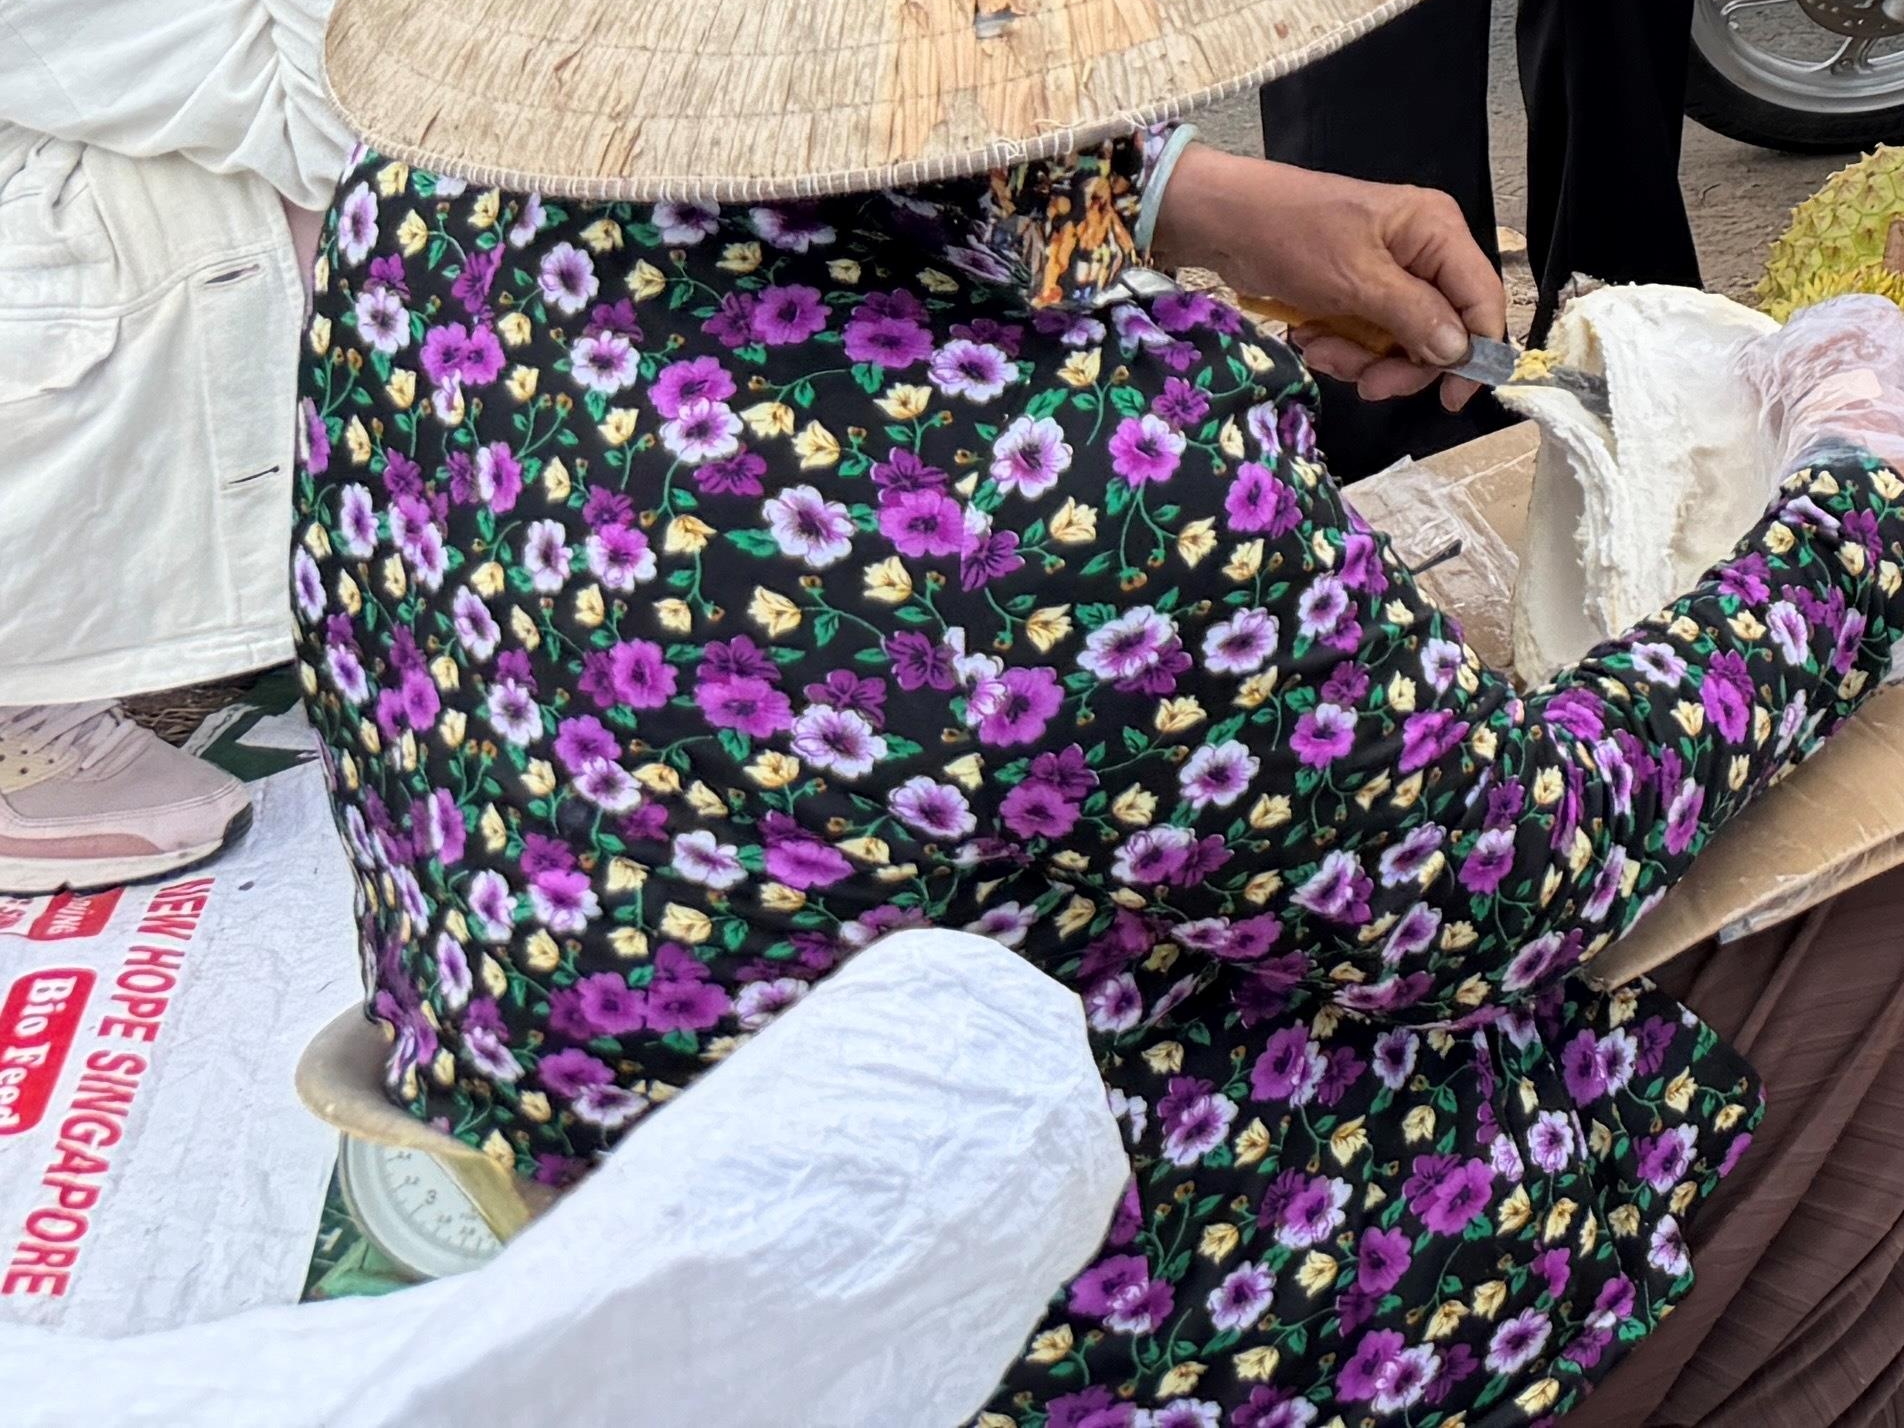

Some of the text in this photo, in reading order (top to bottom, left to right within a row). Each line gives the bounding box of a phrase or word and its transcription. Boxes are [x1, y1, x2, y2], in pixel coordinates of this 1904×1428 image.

[1, 877, 216, 1299] NEW HOPE SINGAPORE
[15, 976, 78, 1038] Bio
